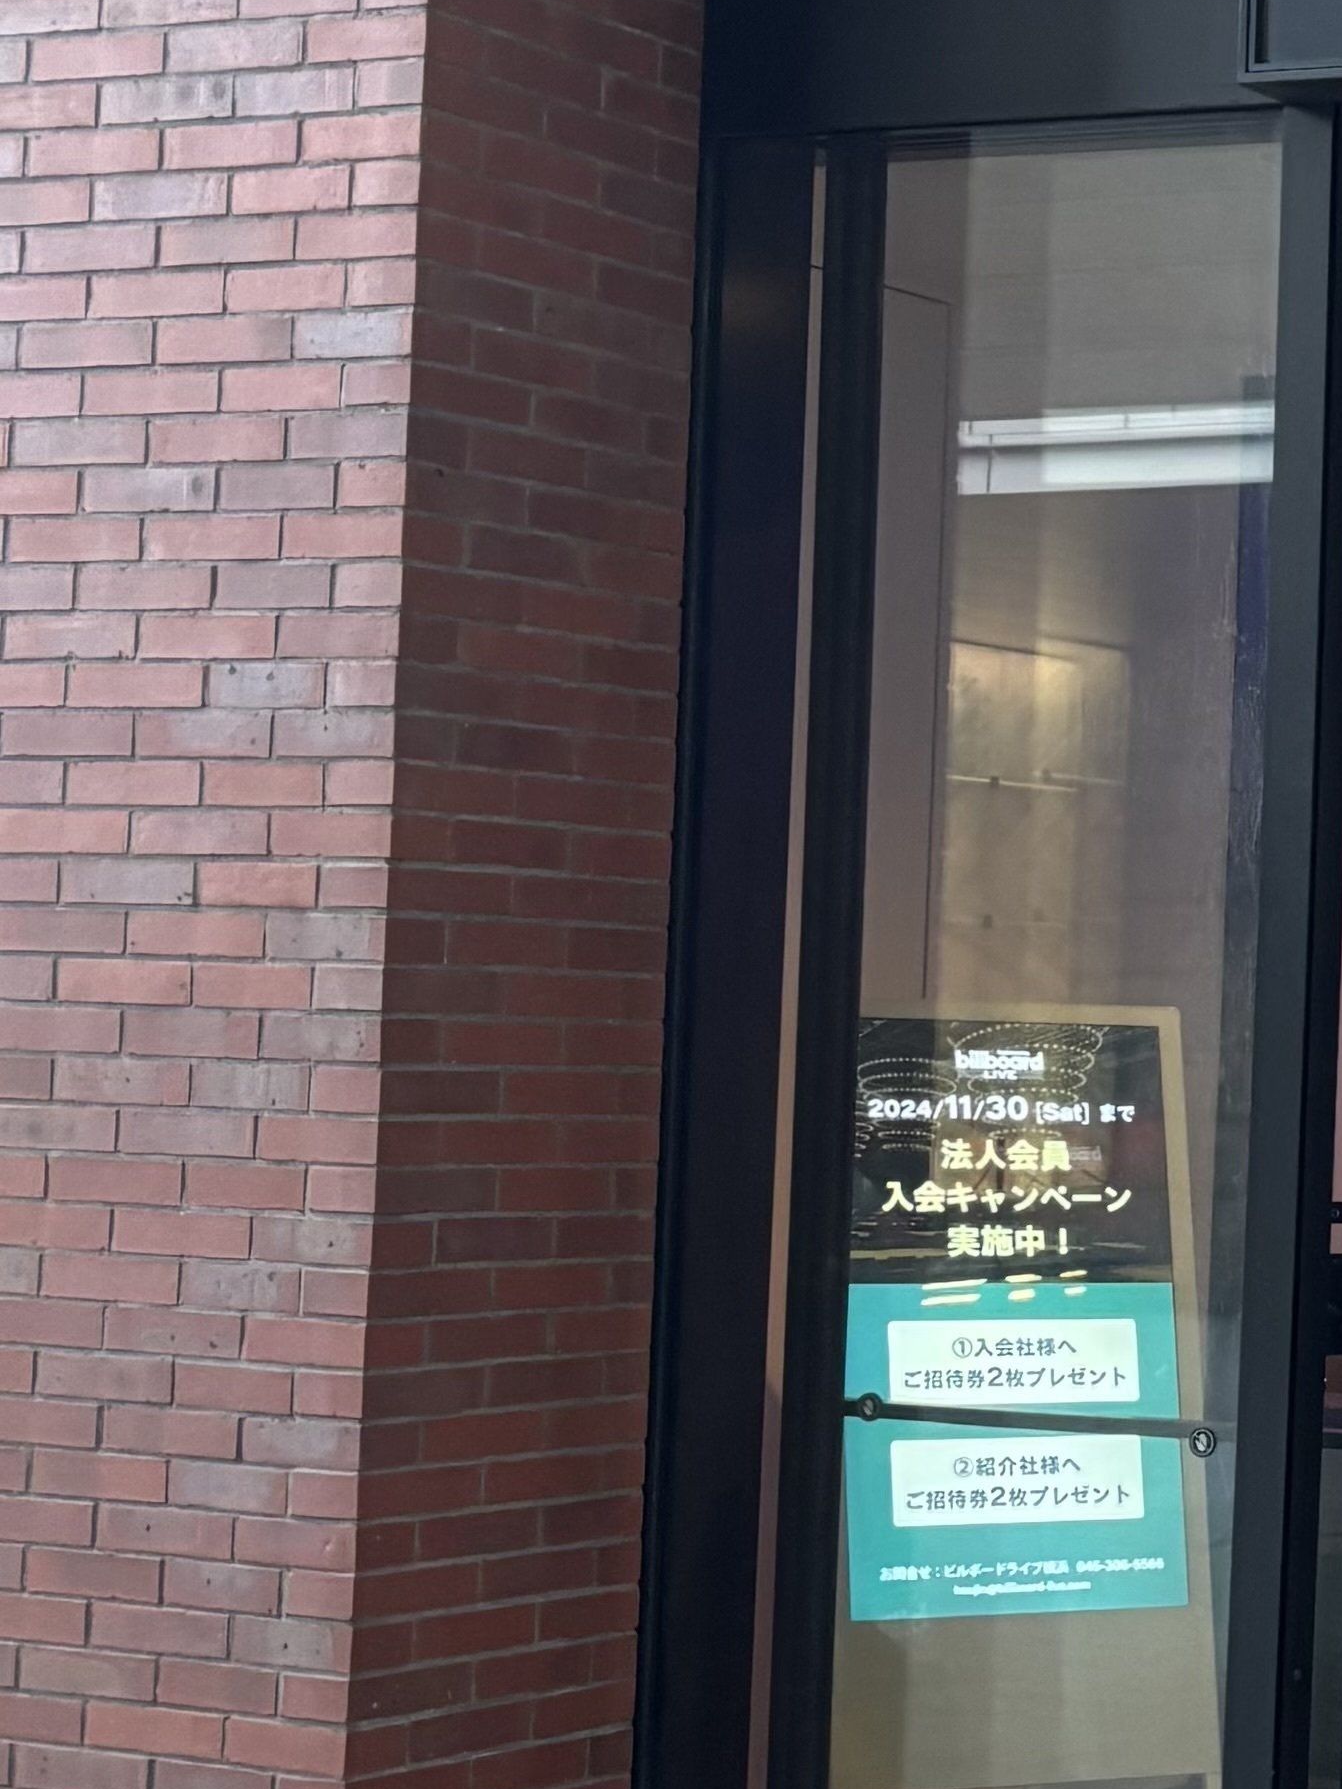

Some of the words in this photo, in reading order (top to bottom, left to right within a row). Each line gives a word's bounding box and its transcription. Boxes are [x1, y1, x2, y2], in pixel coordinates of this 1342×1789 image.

[954, 1050, 1044, 1072] billboard
[983, 1070, 1018, 1081] LIVE
[868, 1094, 1029, 1121] 2024/11/30
[1035, 1101, 1091, 1125] [Sat]
[1099, 1103, 1136, 1123] まで
[941, 1138, 1072, 1172] 法人会員
[882, 1180, 1132, 1214] 入会キャンペーン
[947, 1223, 1069, 1258] 実施中！
[903, 1366, 1127, 1390] ご招待券2枚プレゼント
[905, 1484, 1131, 1511] ご招待券2枚プレゼント
